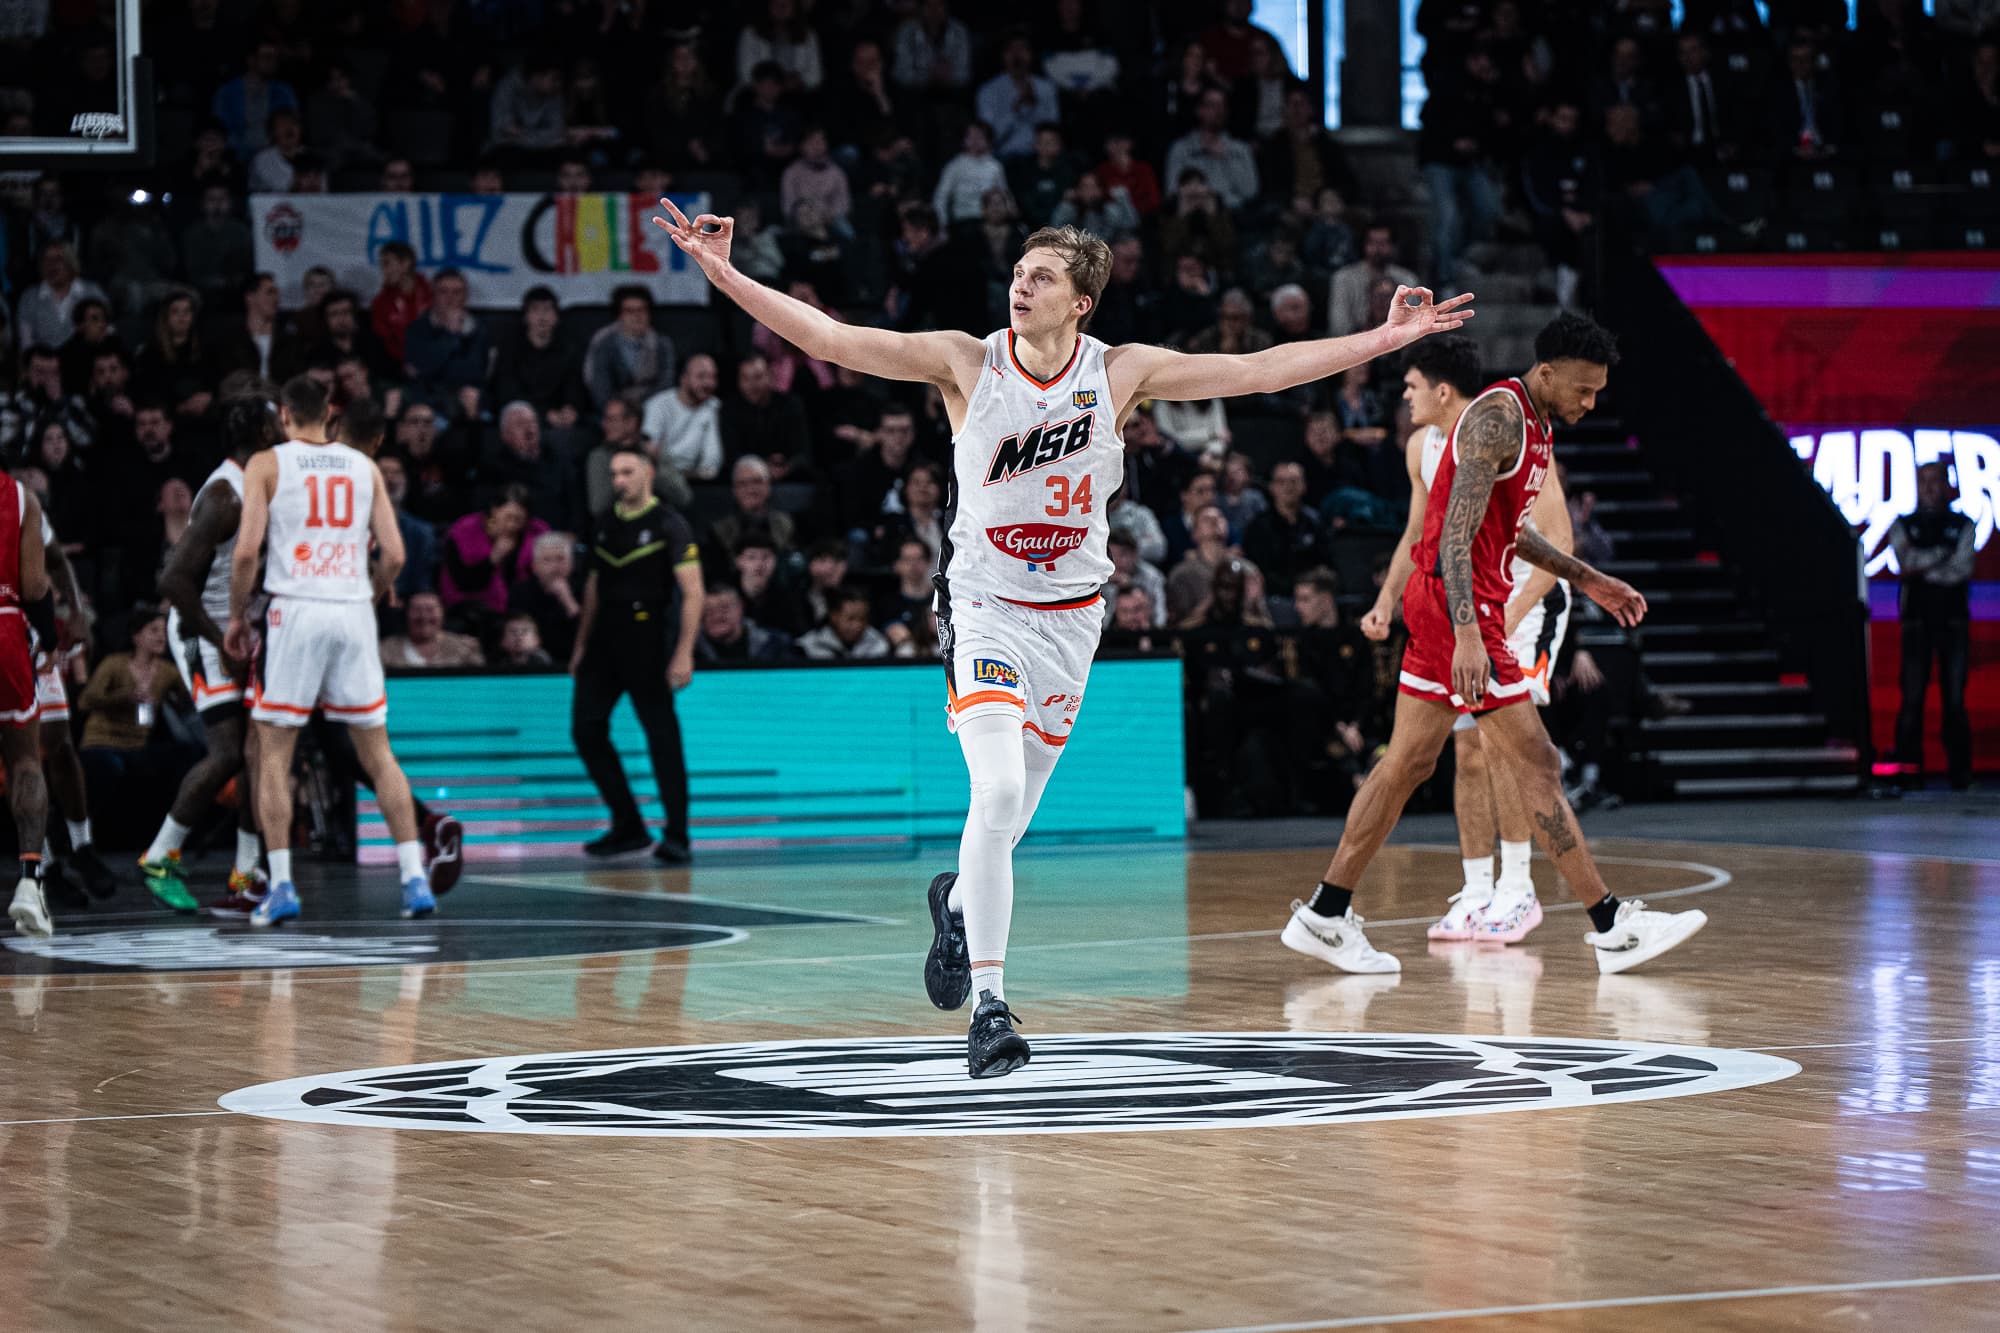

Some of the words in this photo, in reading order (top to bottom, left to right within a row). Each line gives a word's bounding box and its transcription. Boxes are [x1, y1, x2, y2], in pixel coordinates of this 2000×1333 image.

[367, 192, 512, 273] ALLEZ
[986, 412, 1094, 484] MSB
[304, 475, 354, 529] 10
[1045, 474, 1093, 517] 34
[993, 529, 1005, 543] le
[1005, 527, 1083, 553] Gaulois
